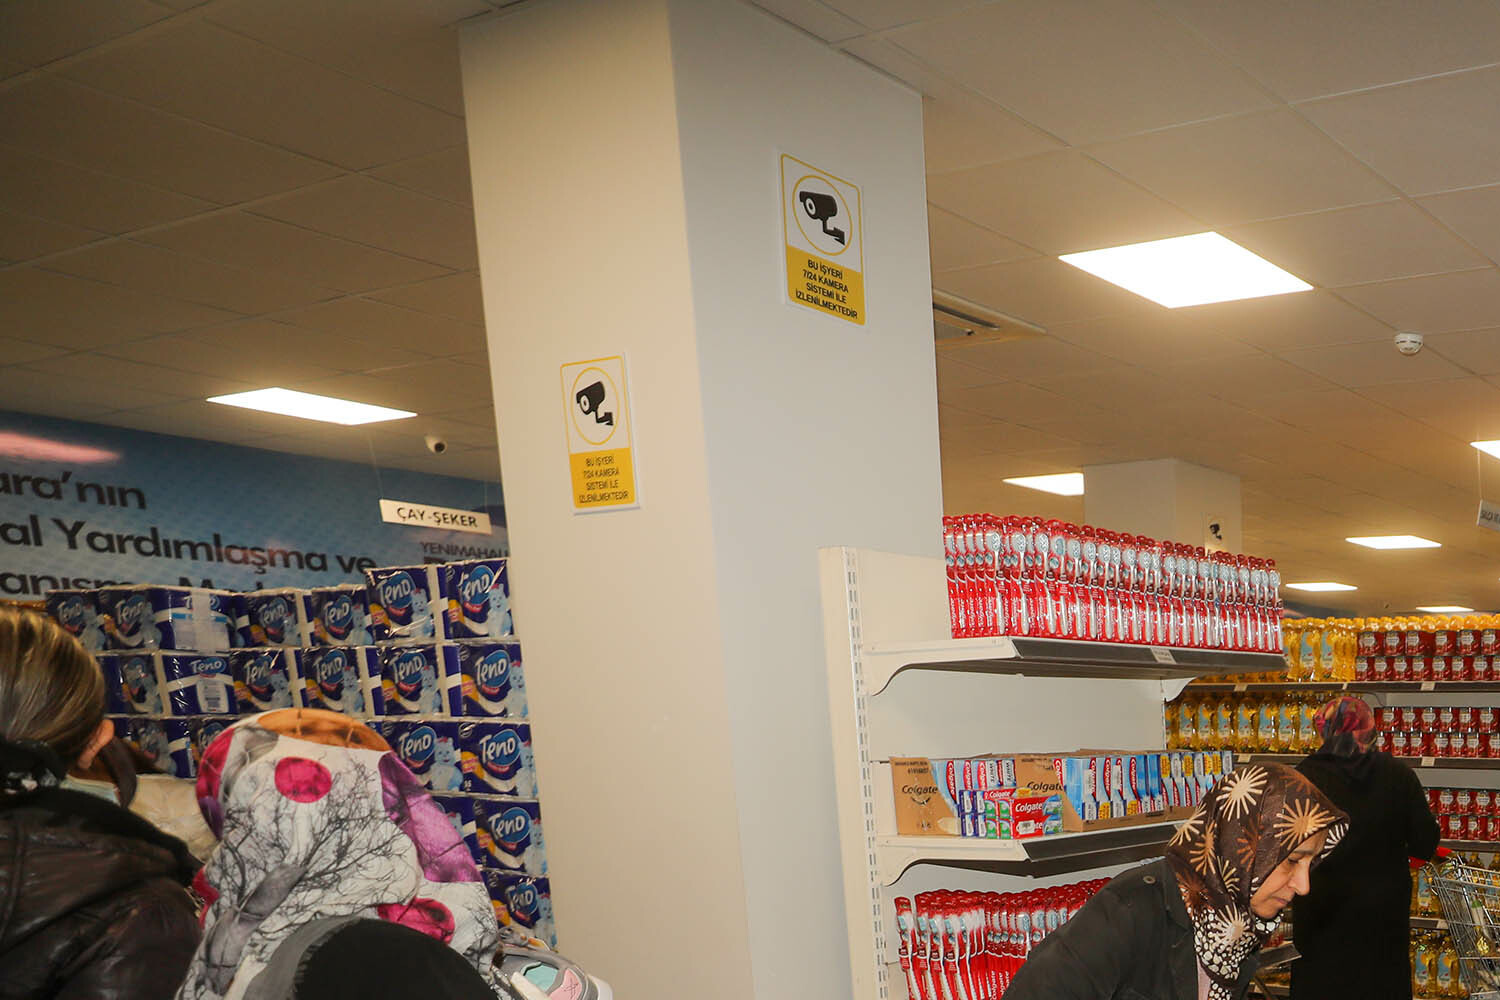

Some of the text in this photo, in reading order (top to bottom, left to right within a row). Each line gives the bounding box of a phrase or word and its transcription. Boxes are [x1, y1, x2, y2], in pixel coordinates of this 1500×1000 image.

[808, 259, 819, 270] BU
[818, 277, 849, 293] KAMERA
[51, 518, 329, 575] Yardımlaşma
[336, 554, 377, 575] ve
[378, 578, 411, 603] Teno
[458, 571, 490, 599] Teno
[190, 659, 222, 674] Teno
[315, 656, 342, 682] Teno
[389, 655, 422, 681] Teno
[475, 655, 507, 682] Teno
[399, 731, 431, 758] Teno
[480, 735, 516, 761] Teno
[902, 784, 938, 796] Colgate
[1015, 802, 1043, 814] Colgate
[489, 813, 525, 839] Teno
